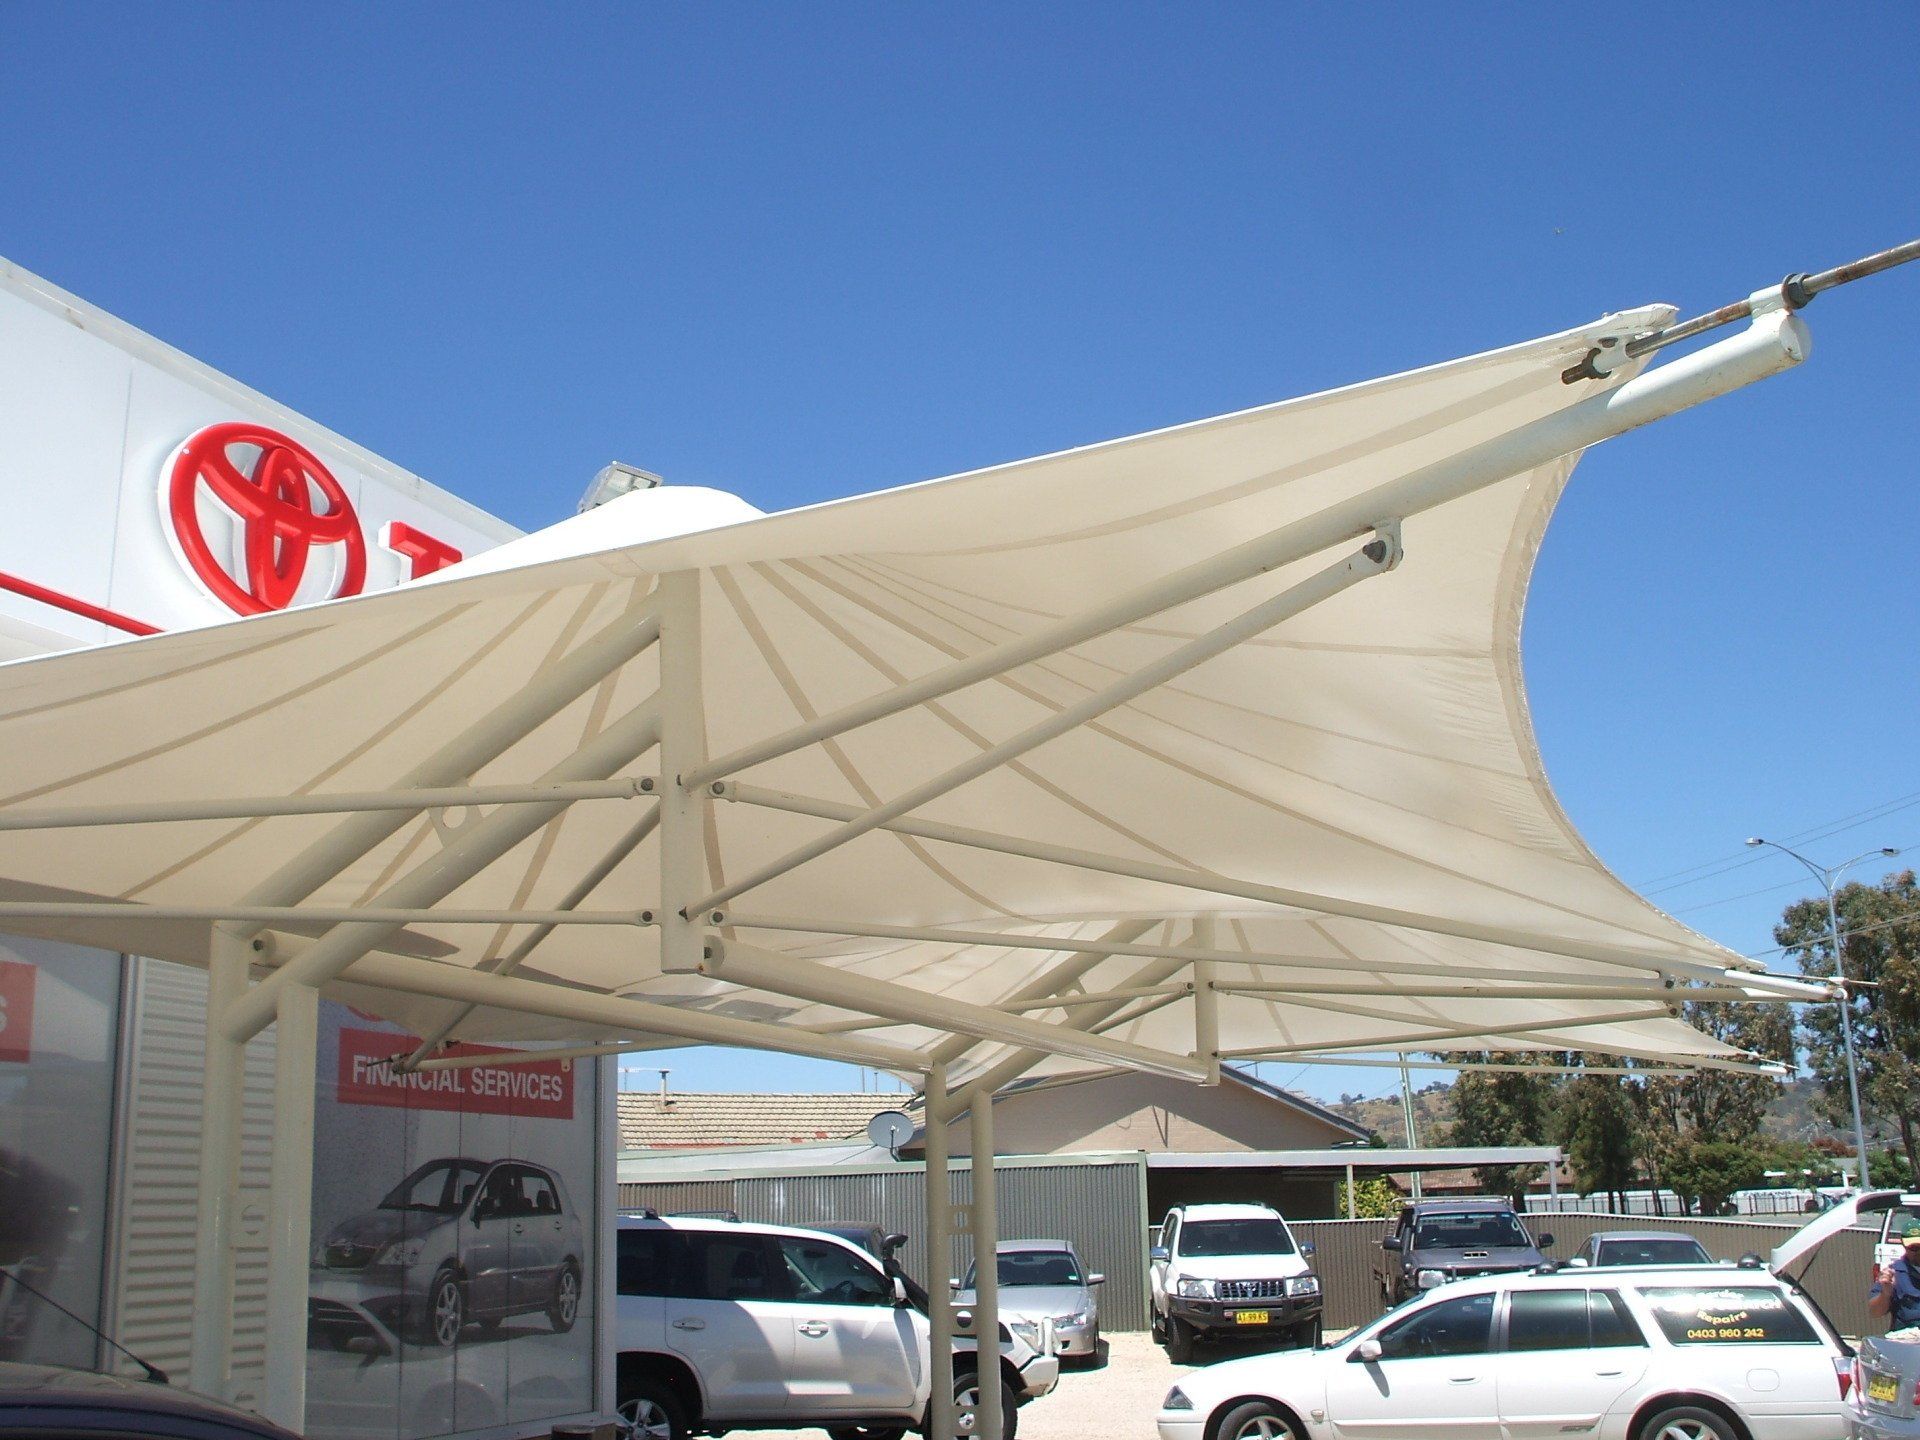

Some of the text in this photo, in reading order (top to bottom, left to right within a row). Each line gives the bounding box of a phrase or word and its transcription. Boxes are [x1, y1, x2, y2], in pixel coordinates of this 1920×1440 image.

[470, 1067, 563, 1102] SERVICES
[1696, 1310, 1748, 1326] Repairs
[1687, 1327, 1765, 1338] 0403 960 242
